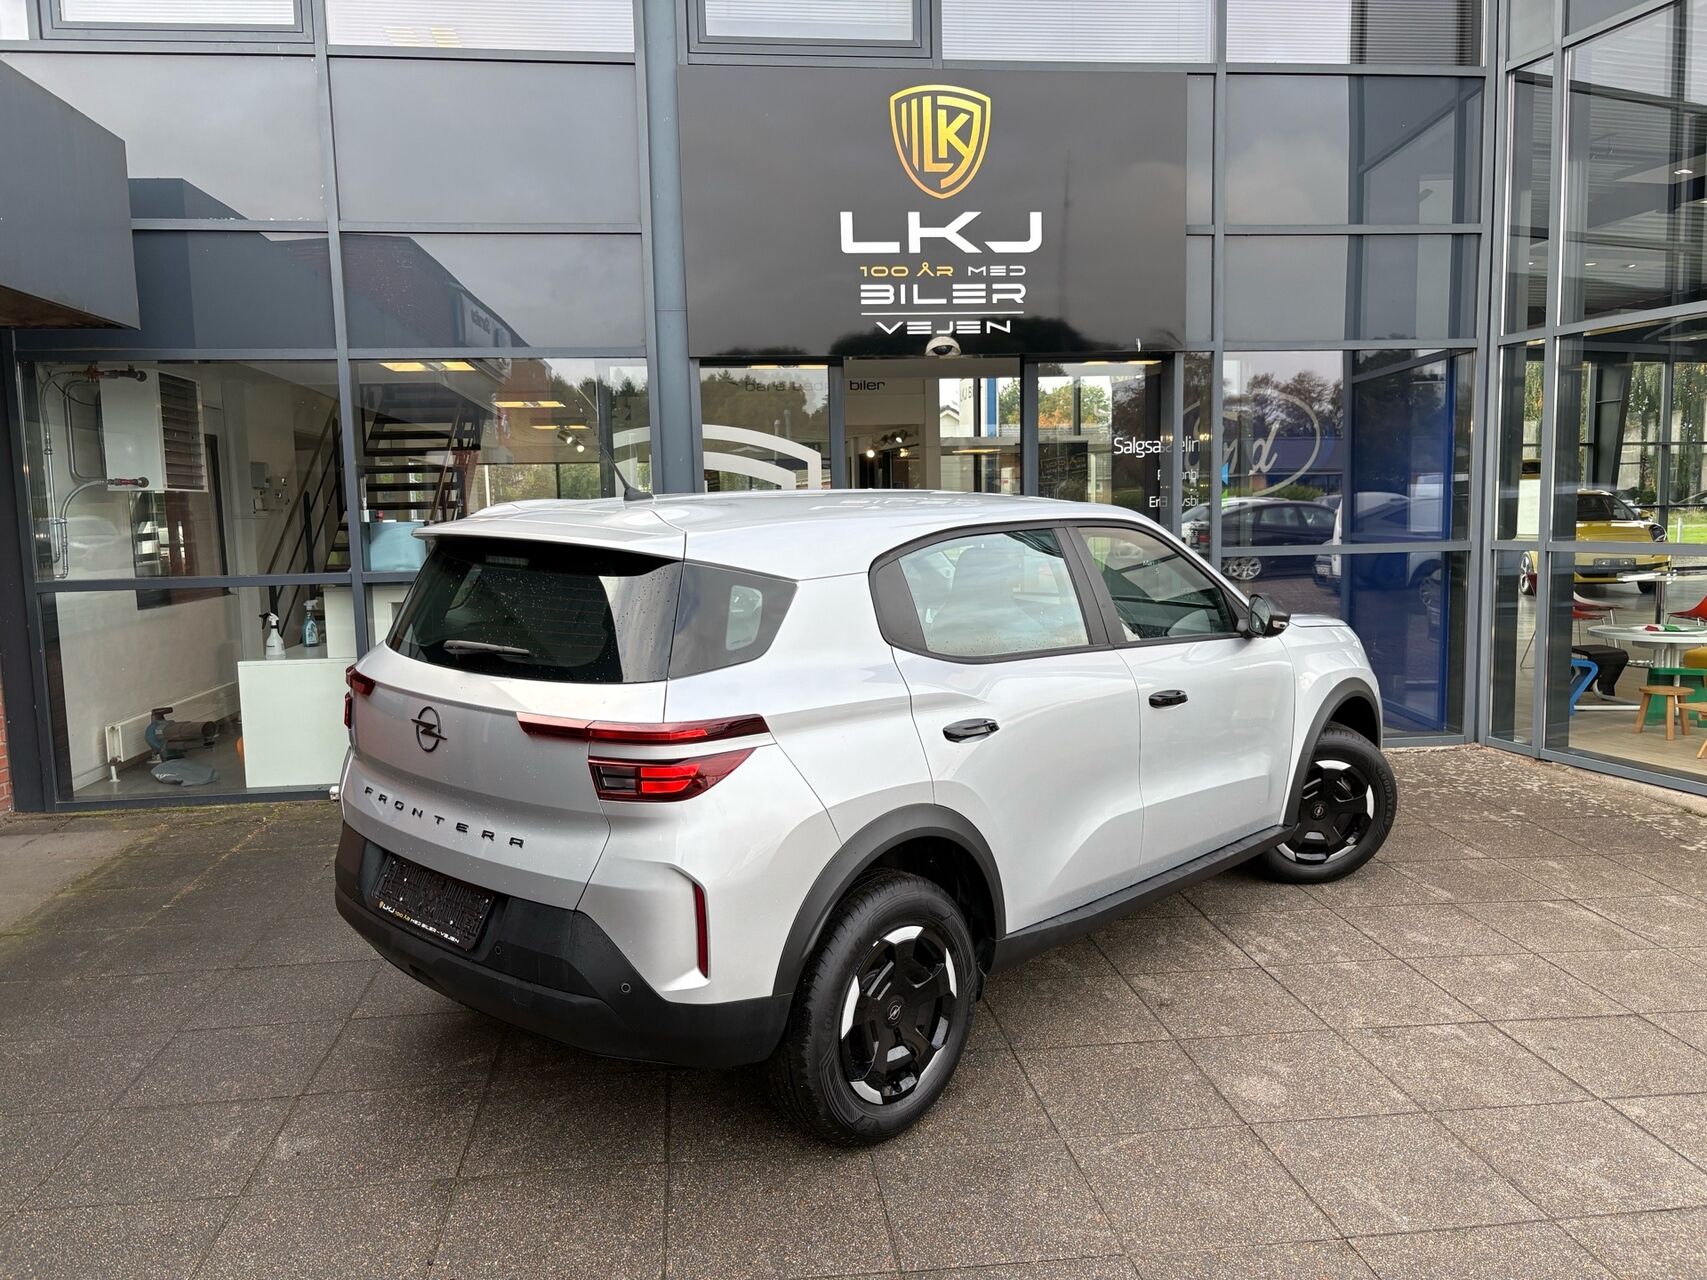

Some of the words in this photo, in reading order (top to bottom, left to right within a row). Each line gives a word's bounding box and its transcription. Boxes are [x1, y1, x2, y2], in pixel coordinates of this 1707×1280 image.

[840, 210, 1043, 254] LKJ
[859, 265, 909, 277] 100
[916, 261, 954, 277] ÅR
[967, 265, 1027, 277] MED
[860, 283, 1027, 305] BILER
[875, 320, 1011, 335] VEJEN
[849, 380, 886, 391] biler
[364, 785, 525, 849] FRONTERA
[440, 931, 460, 944] VEJEN
